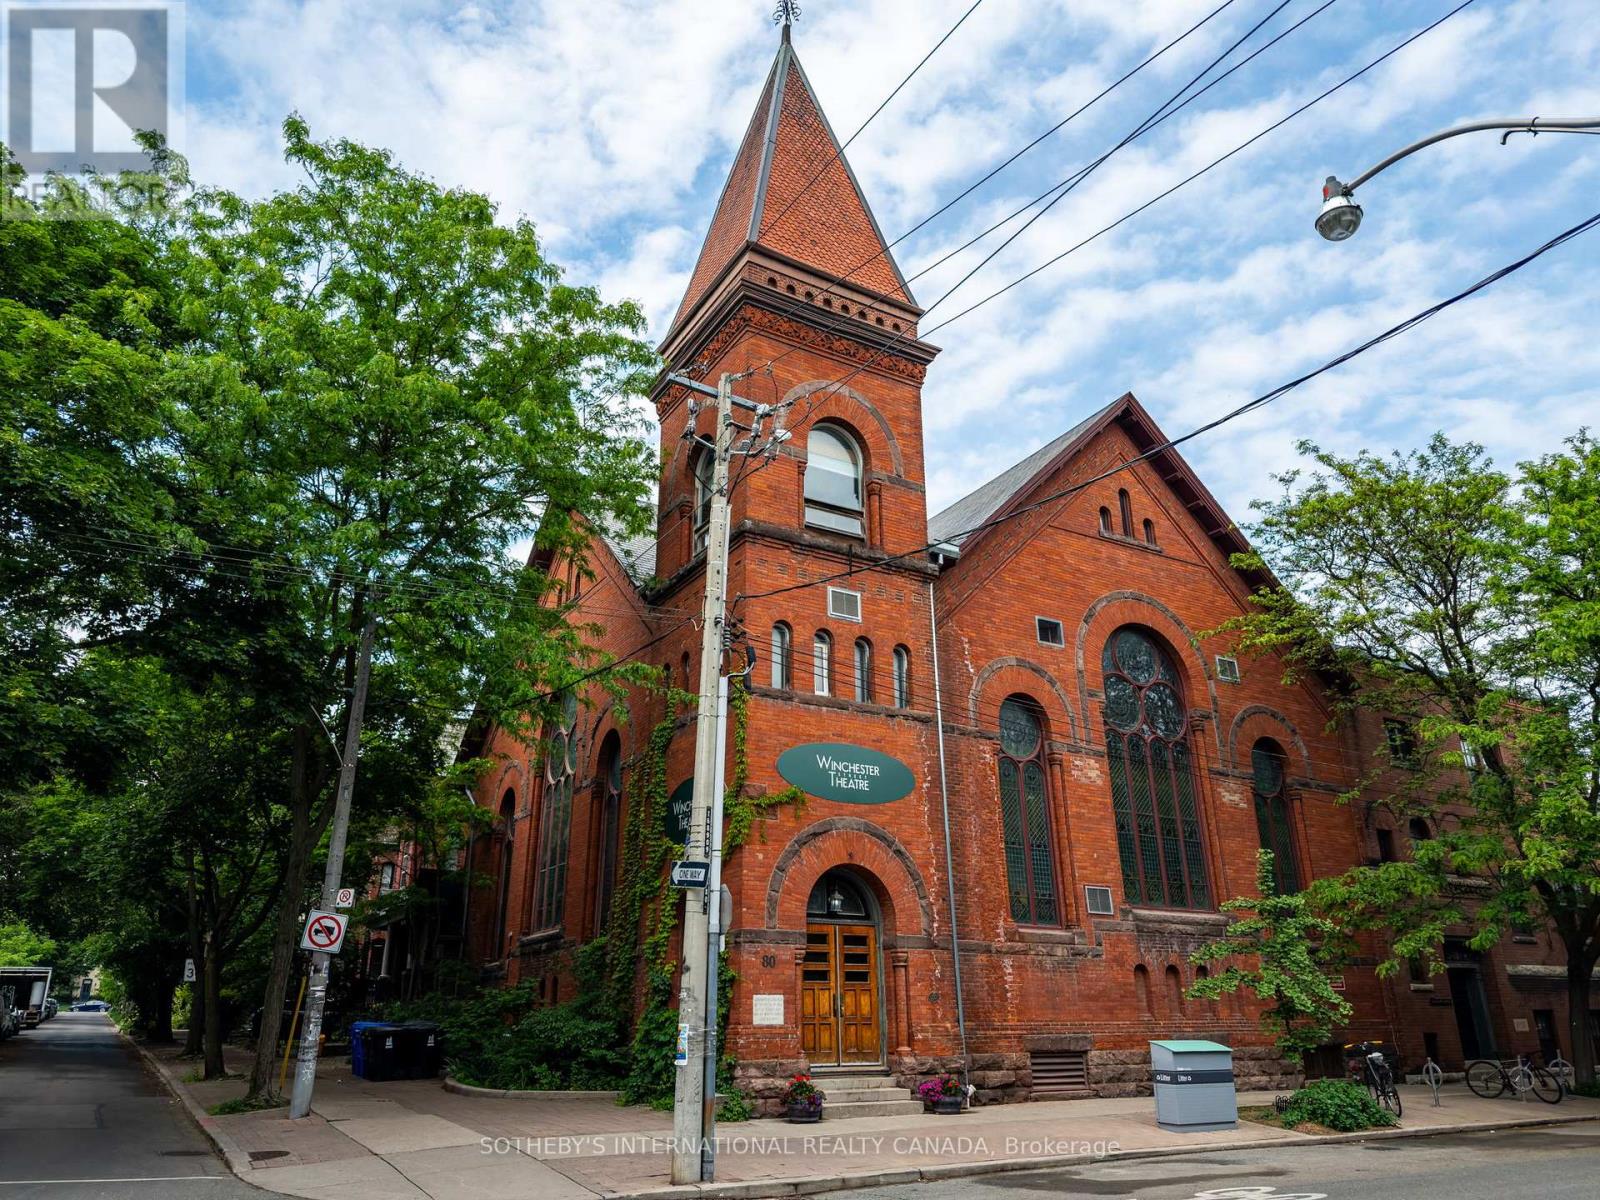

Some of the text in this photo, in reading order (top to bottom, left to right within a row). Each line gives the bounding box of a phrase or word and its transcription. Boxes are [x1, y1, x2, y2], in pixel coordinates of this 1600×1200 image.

[816, 754, 880, 776] WINCHESTER
[828, 771, 870, 791] THEATRE
[679, 869, 702, 880] ONE WAY
